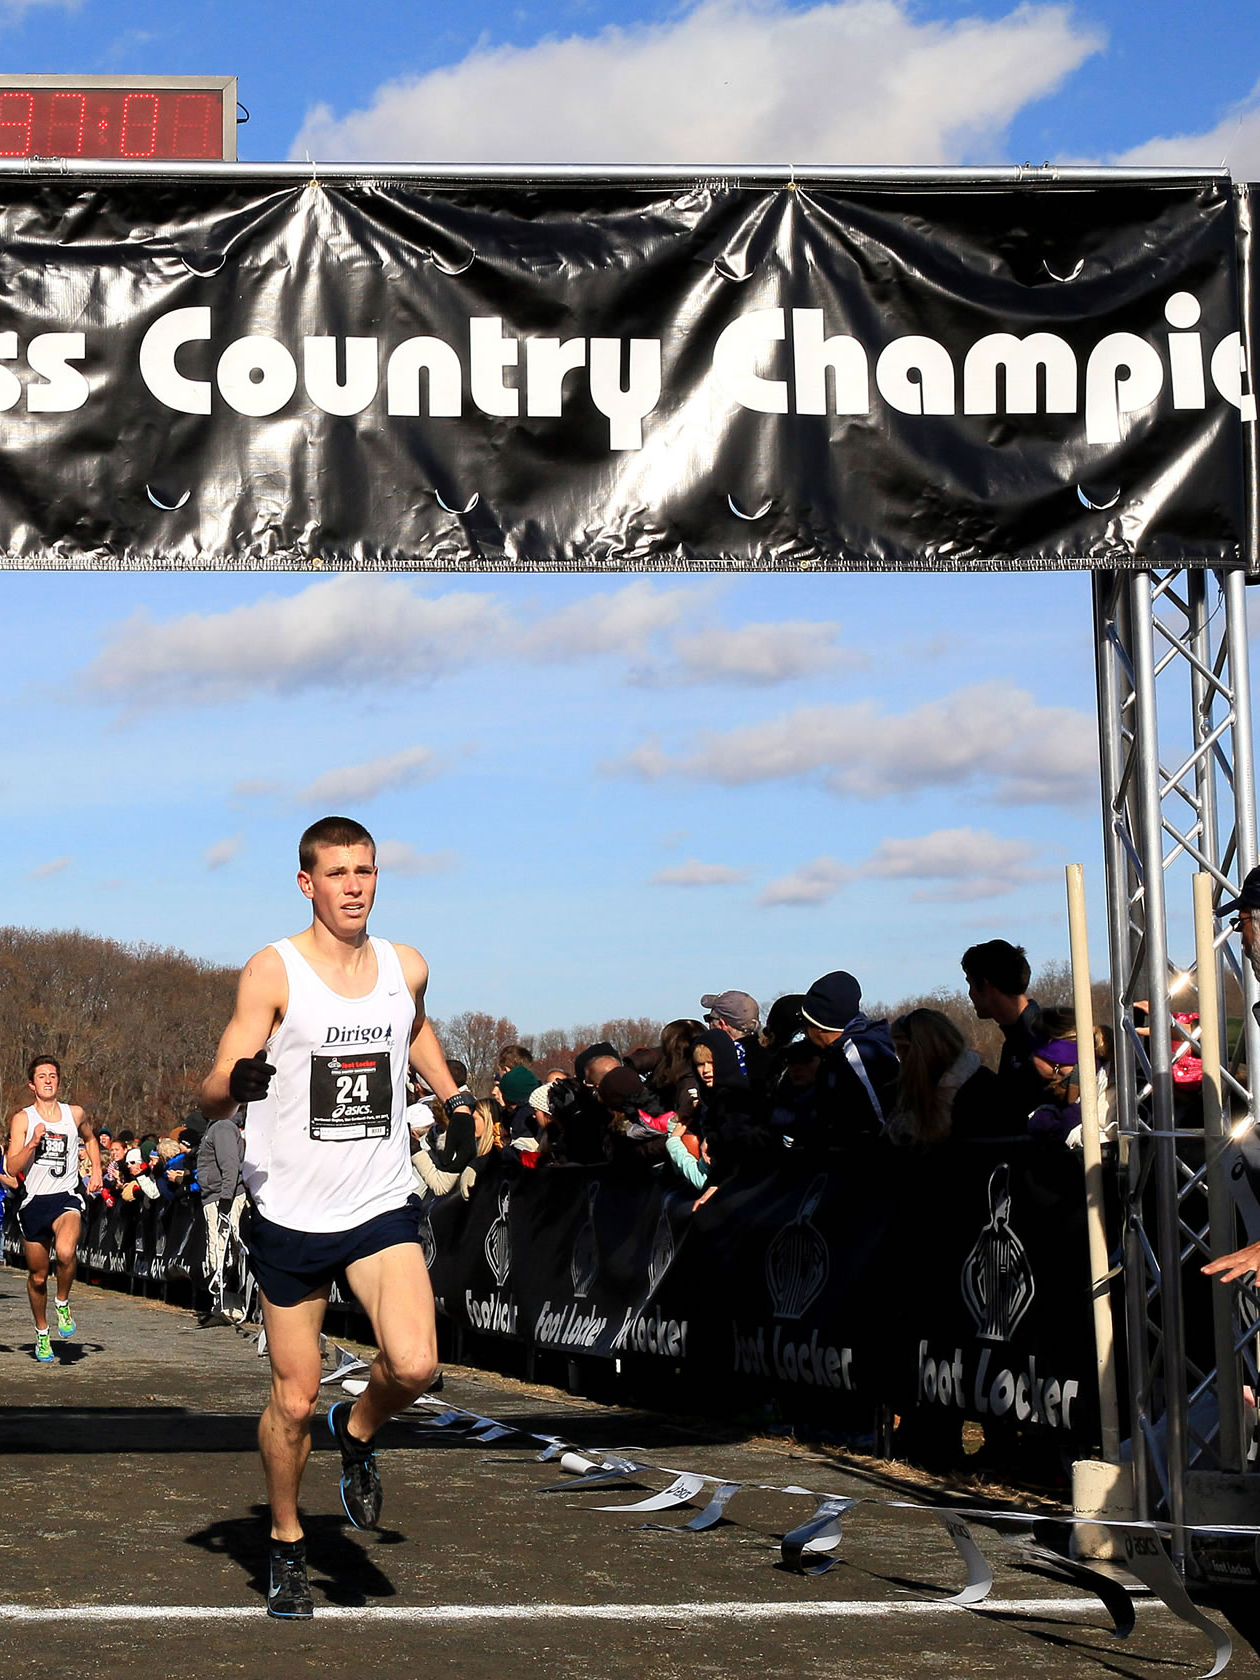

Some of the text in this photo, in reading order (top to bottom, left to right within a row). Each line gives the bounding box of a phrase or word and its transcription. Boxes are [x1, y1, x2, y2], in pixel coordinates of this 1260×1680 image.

[139, 306, 661, 450] Country
[324, 1025, 383, 1044] Dirigo
[336, 1074, 370, 1104] 24
[534, 1300, 569, 1343] Foot
[772, 1324, 853, 1391] Locker
[917, 1339, 1080, 1430] Foot Locker
